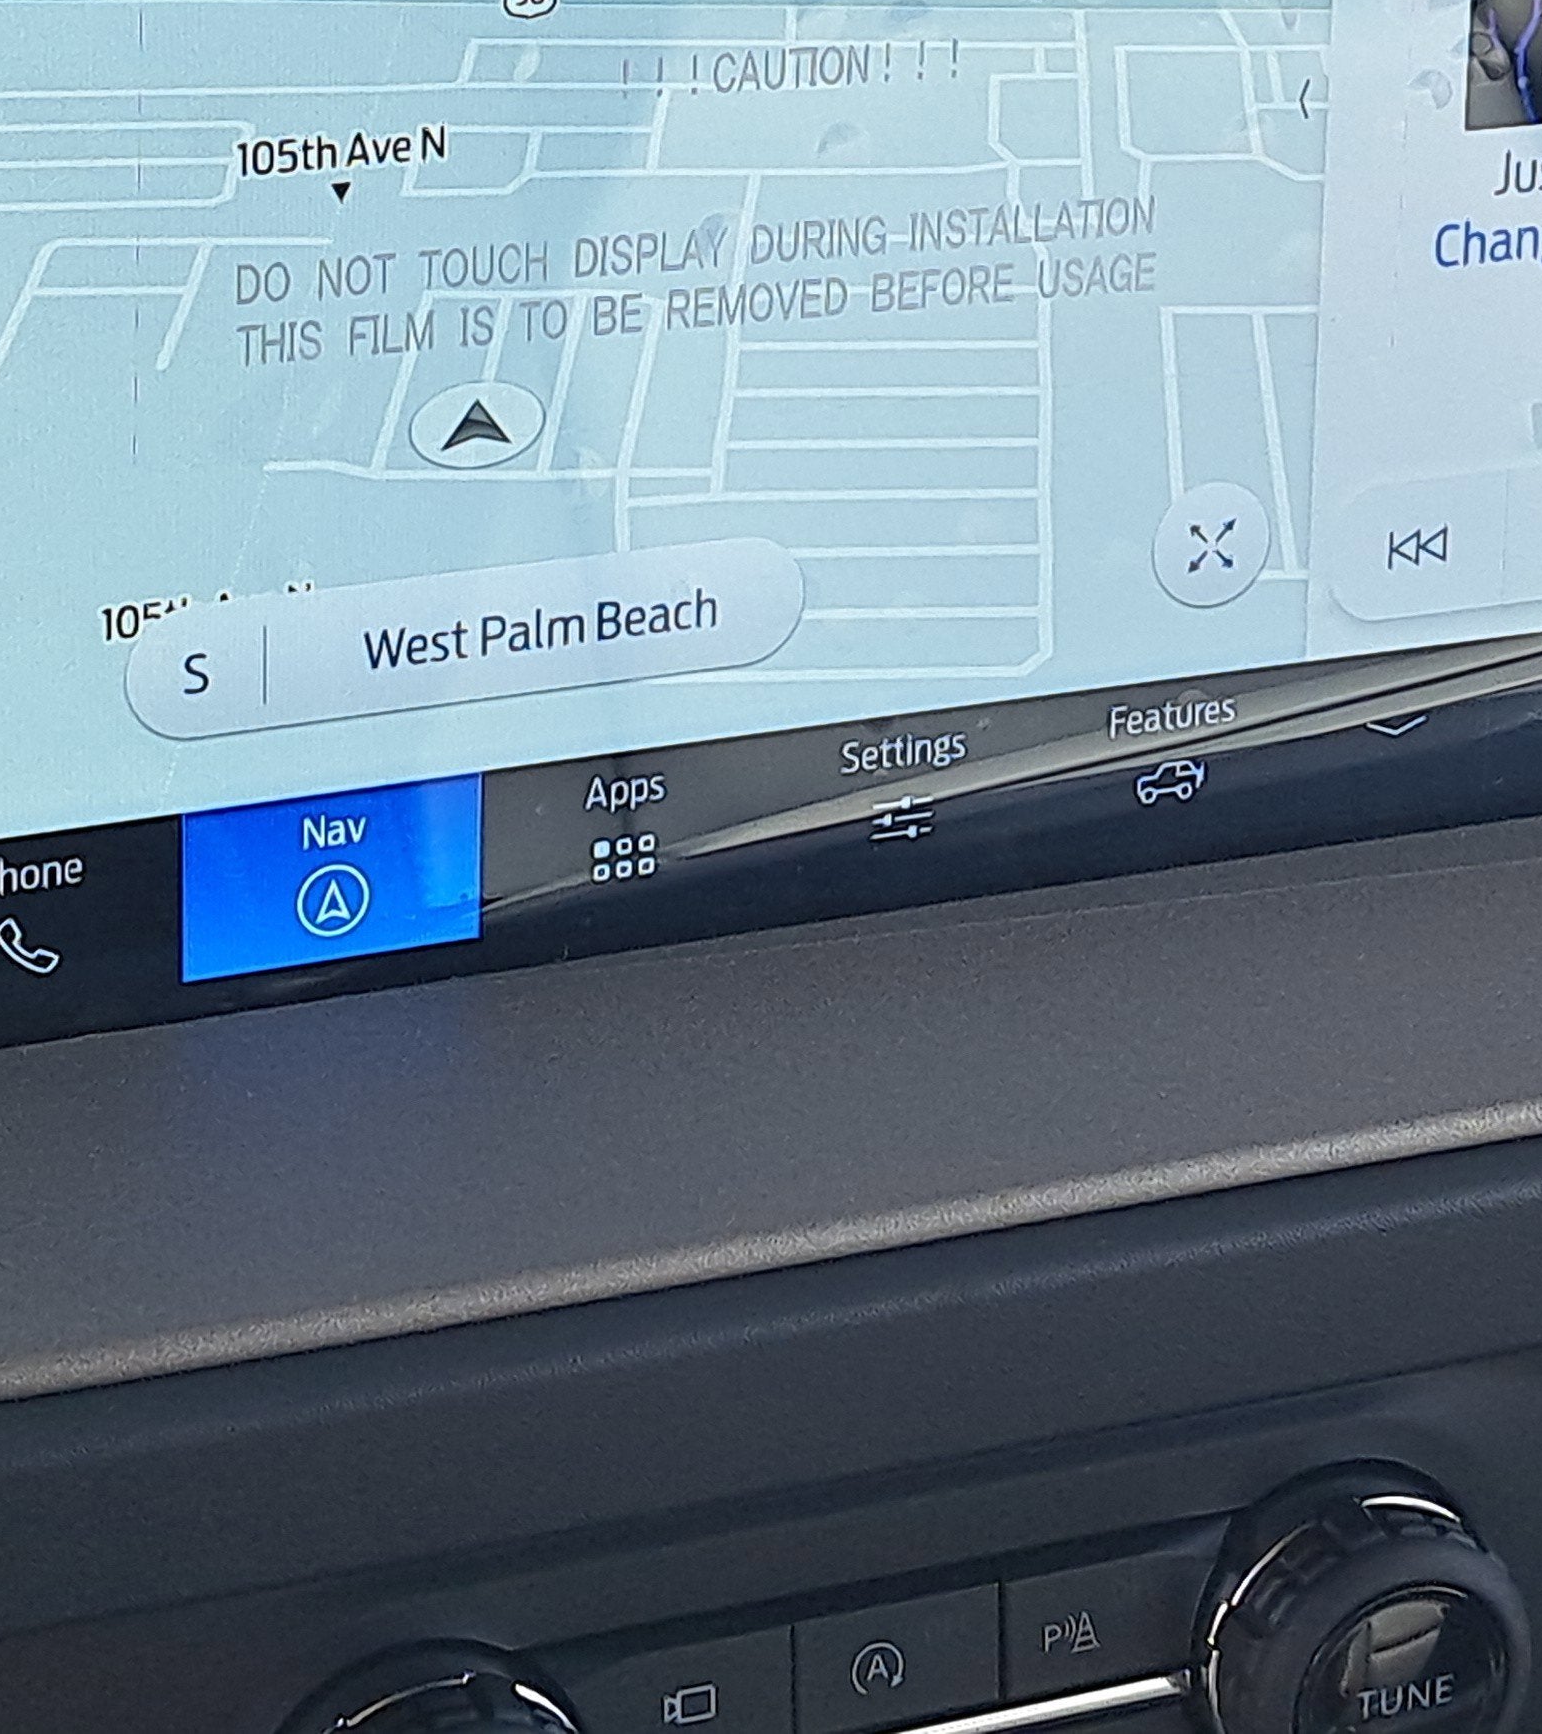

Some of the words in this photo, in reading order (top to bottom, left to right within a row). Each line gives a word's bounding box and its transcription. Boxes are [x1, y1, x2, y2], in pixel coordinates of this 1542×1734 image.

[236, 133, 338, 177] 105th
[346, 130, 412, 167] Ave
[420, 125, 447, 163] N
[235, 261, 291, 306] DO
[316, 252, 396, 302] NOT
[418, 241, 549, 291] TOUCH
[574, 226, 730, 279] DISPLAY
[749, 214, 888, 265] DURING
[907, 195, 1156, 252] INSTALLATION
[235, 319, 323, 366] THIS
[349, 308, 435, 357] FILM
[459, 305, 494, 348] IS
[520, 298, 567, 344] TO
[592, 292, 643, 337] BE
[665, 276, 849, 332] REMOVED
[870, 263, 1014, 313] BEFORE
[1036, 251, 1157, 300] USAGE
[364, 620, 469, 670] West
[480, 608, 586, 657] Palm
[597, 588, 718, 642] Beach
[183, 652, 210, 695] S
[1109, 696, 1237, 739] Features
[840, 732, 967, 775] Settings
[585, 773, 666, 812] Apps
[302, 816, 366, 851] Nav
[1358, 1673, 1455, 1720] TUNE
